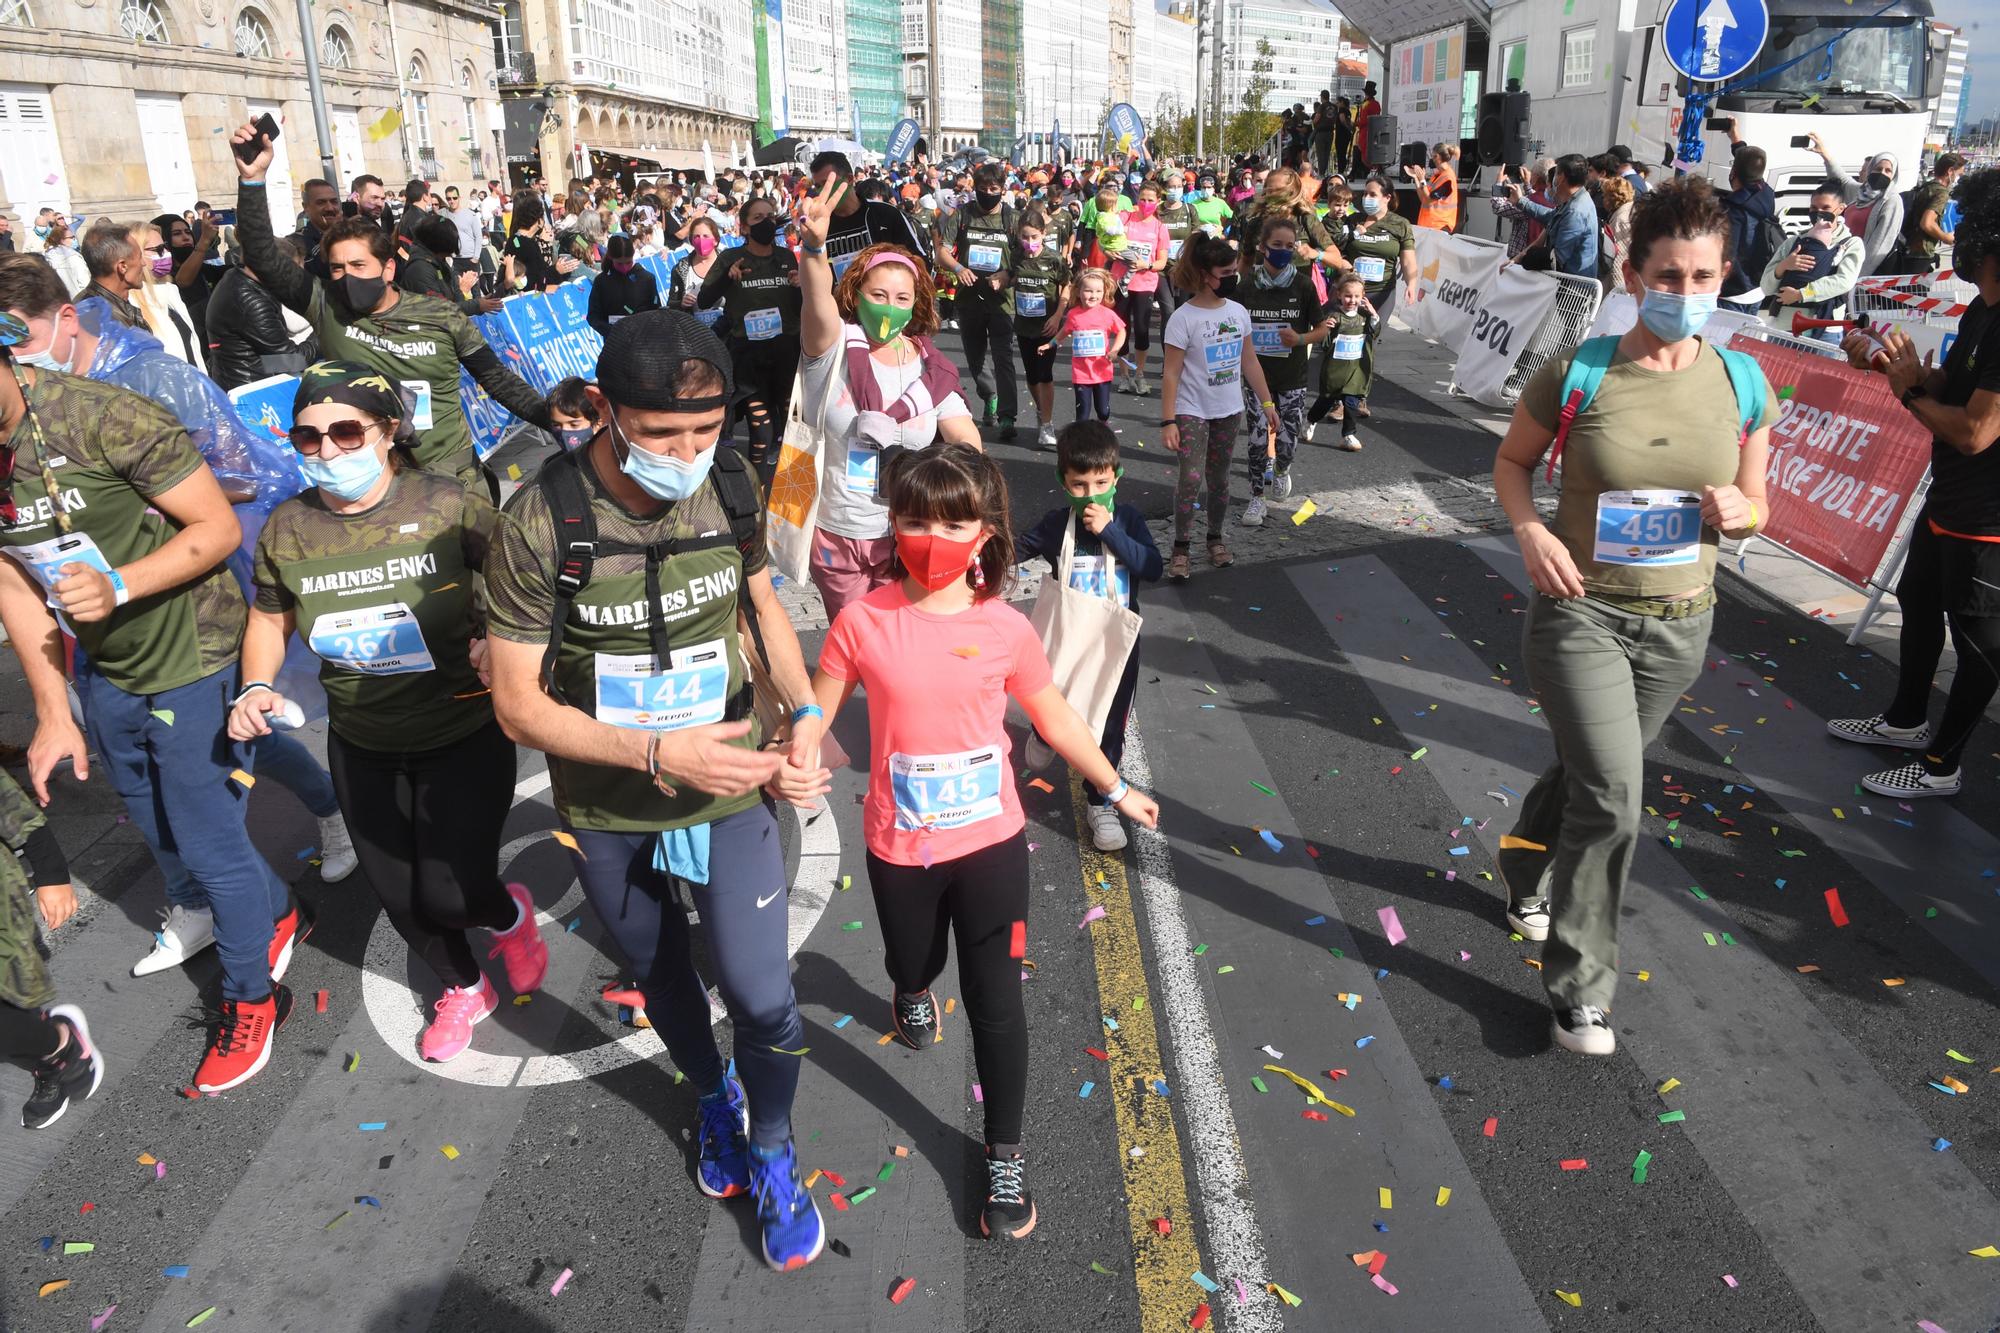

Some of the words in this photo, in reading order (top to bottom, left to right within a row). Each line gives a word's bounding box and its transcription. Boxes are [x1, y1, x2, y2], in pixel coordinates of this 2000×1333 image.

[741, 278, 775, 288] MARINES
[749, 318, 773, 332] 187
[402, 341, 437, 357] ENKI
[1215, 342, 1239, 359] 447
[1781, 455, 1824, 497] DE
[1807, 468, 1901, 534] VOLTA
[1620, 512, 1682, 542] 450
[301, 566, 384, 595] MARINES
[386, 552, 437, 582] ENKI
[688, 565, 737, 606] ENKI
[334, 629, 397, 660] 267
[628, 673, 702, 707] 144
[913, 772, 980, 809] 145
